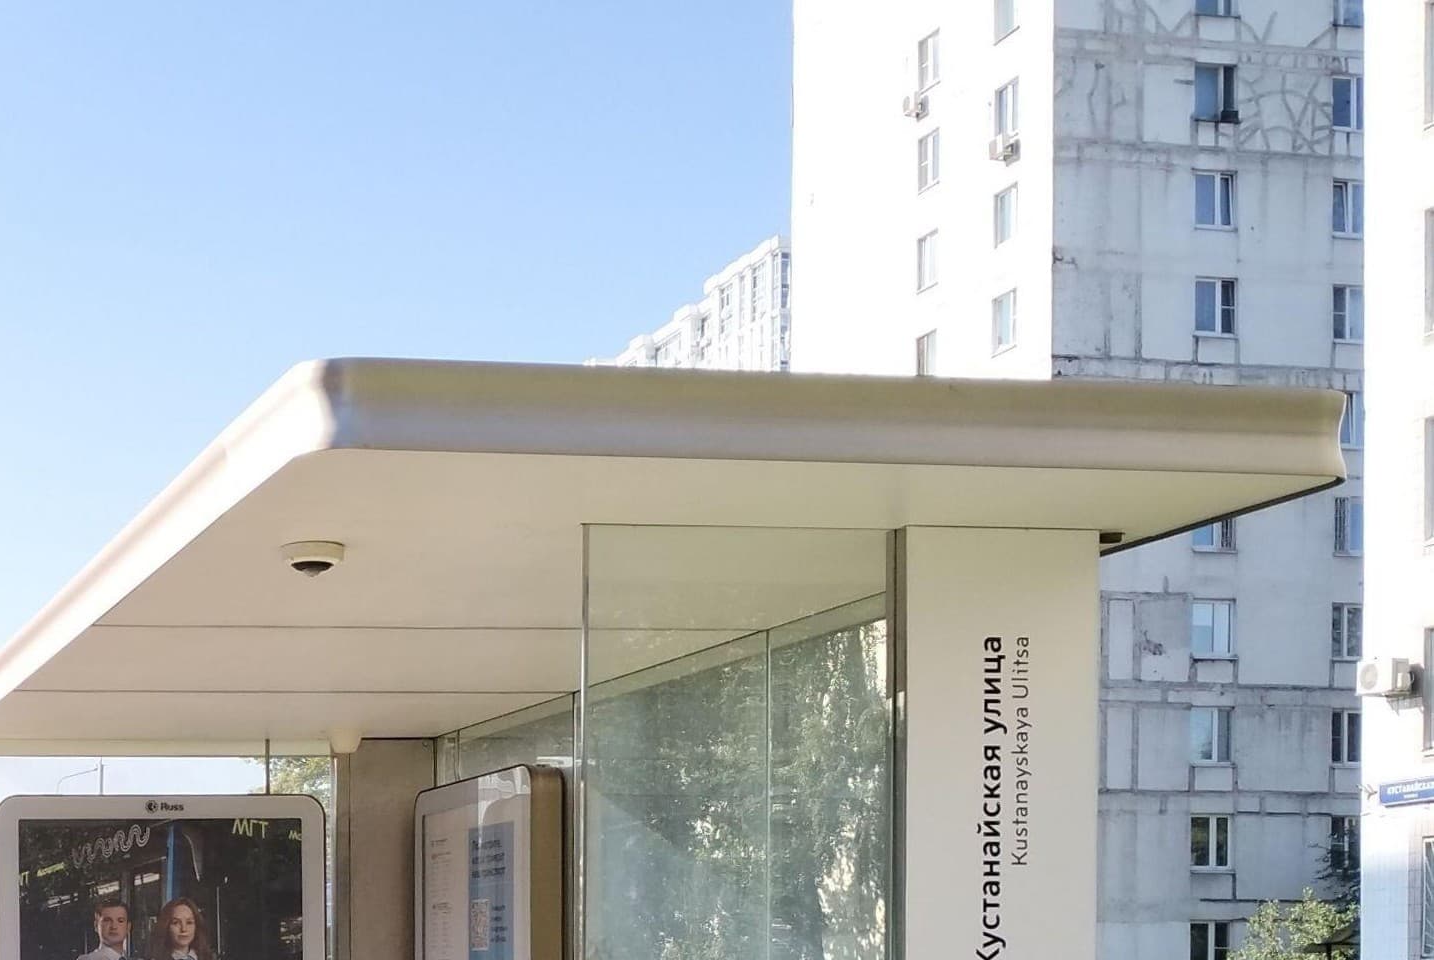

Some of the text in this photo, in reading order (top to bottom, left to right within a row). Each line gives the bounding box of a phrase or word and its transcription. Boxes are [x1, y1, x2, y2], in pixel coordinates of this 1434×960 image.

[983, 636, 1007, 734] улица
[1011, 636, 1032, 866] Kustanayskaya Ulitsa
